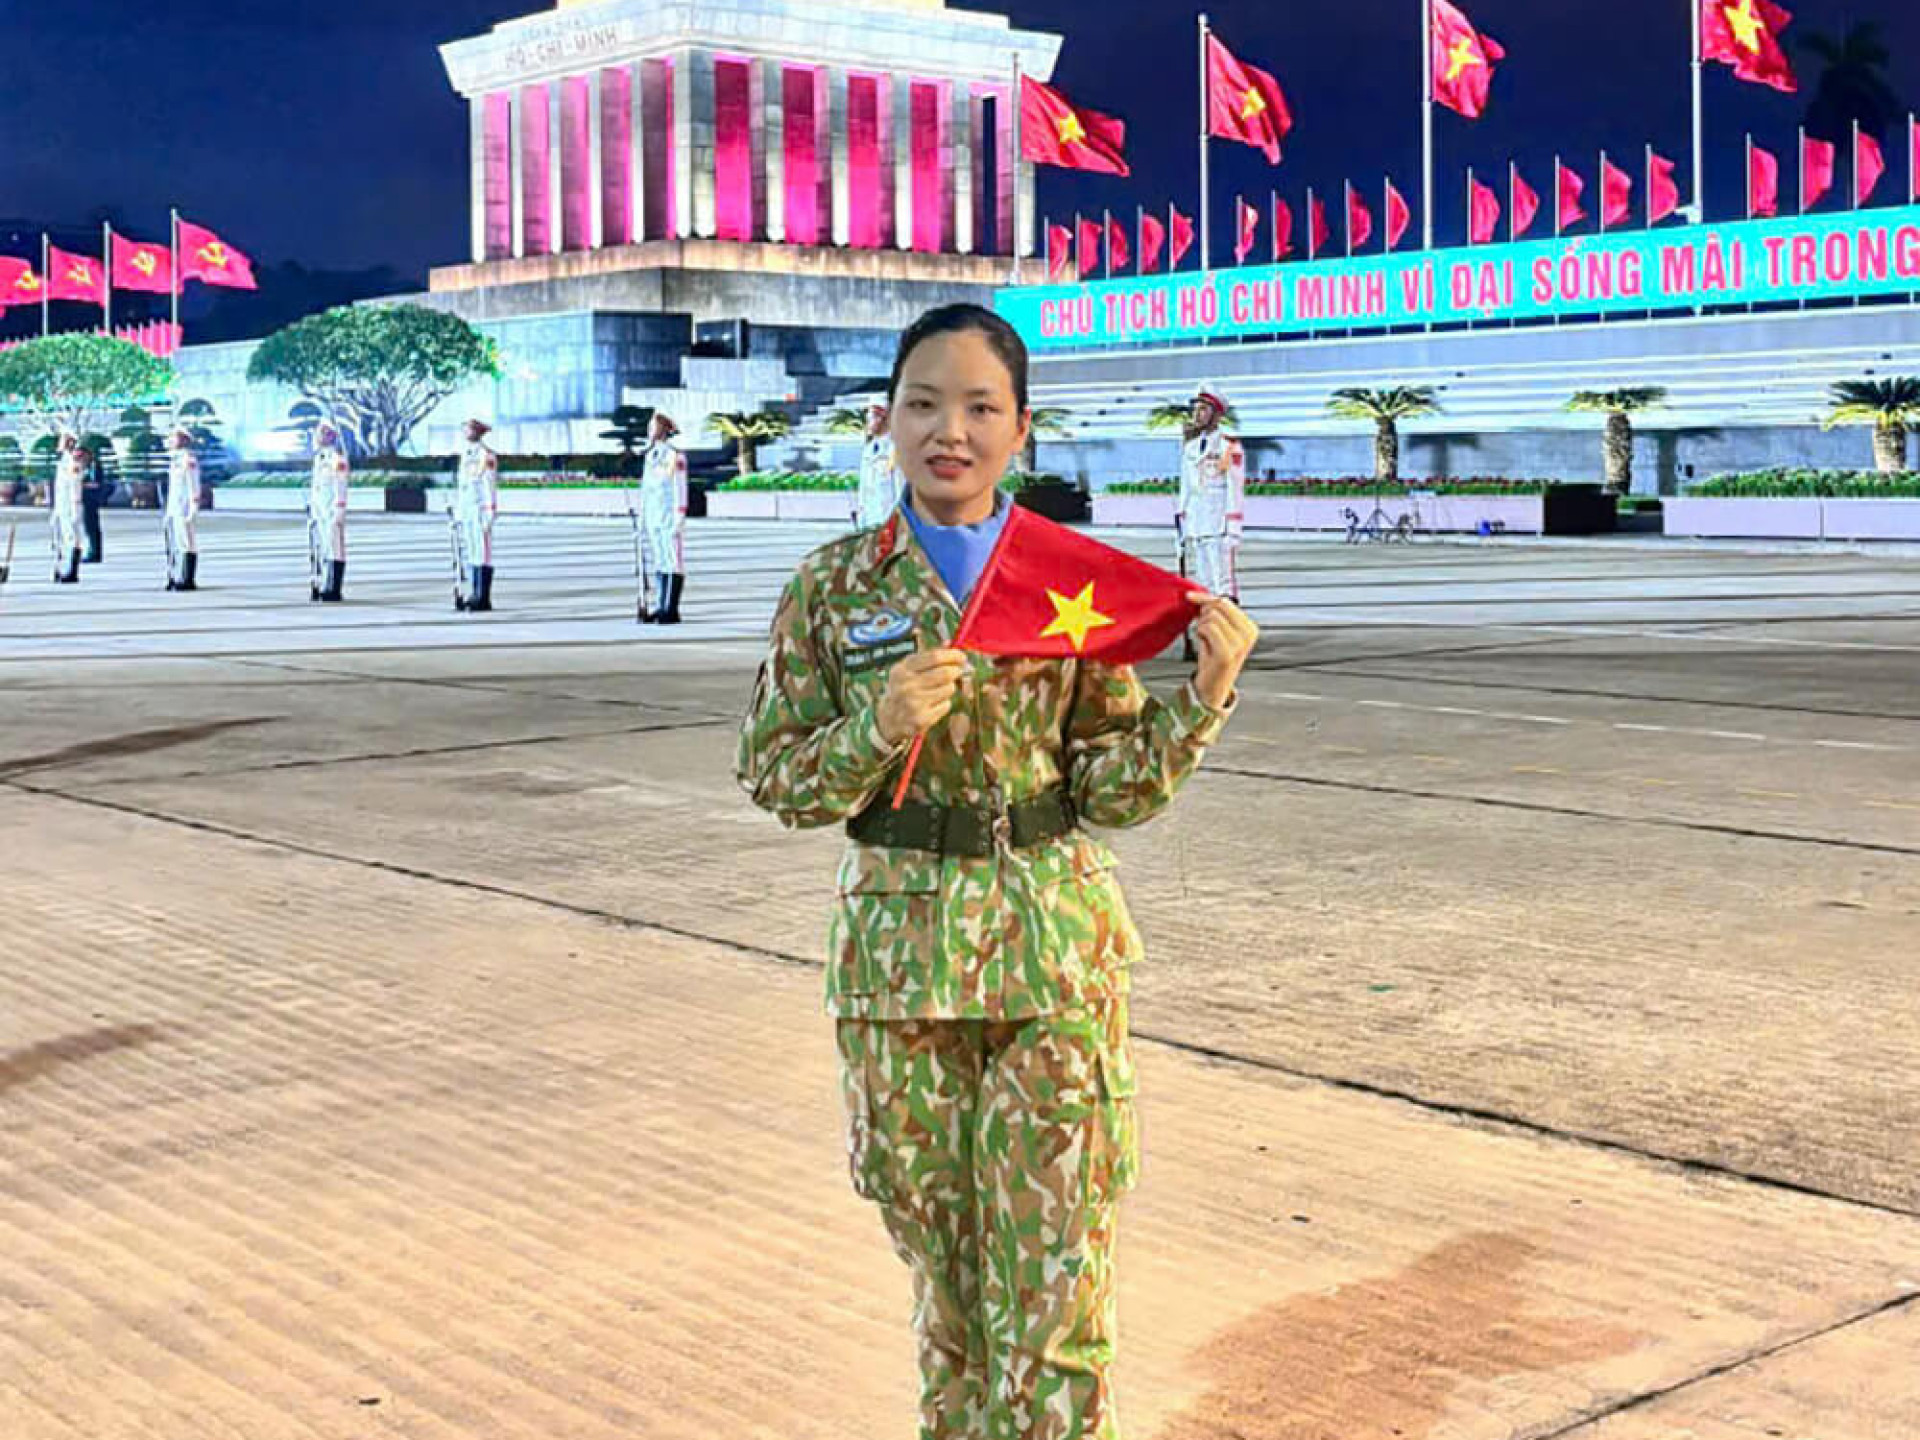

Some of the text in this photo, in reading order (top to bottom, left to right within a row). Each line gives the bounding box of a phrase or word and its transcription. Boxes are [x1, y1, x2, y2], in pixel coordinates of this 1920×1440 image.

[1104, 289, 1168, 338] TỊCH
[1232, 271, 1283, 323] CHÍ
[1296, 269, 1385, 319] MINH
[1451, 259, 1514, 316] ĐẠI
[1532, 237, 1642, 303] SỐNG
[1662, 234, 1743, 294] MÃI
[1763, 225, 1920, 287] TRONG
